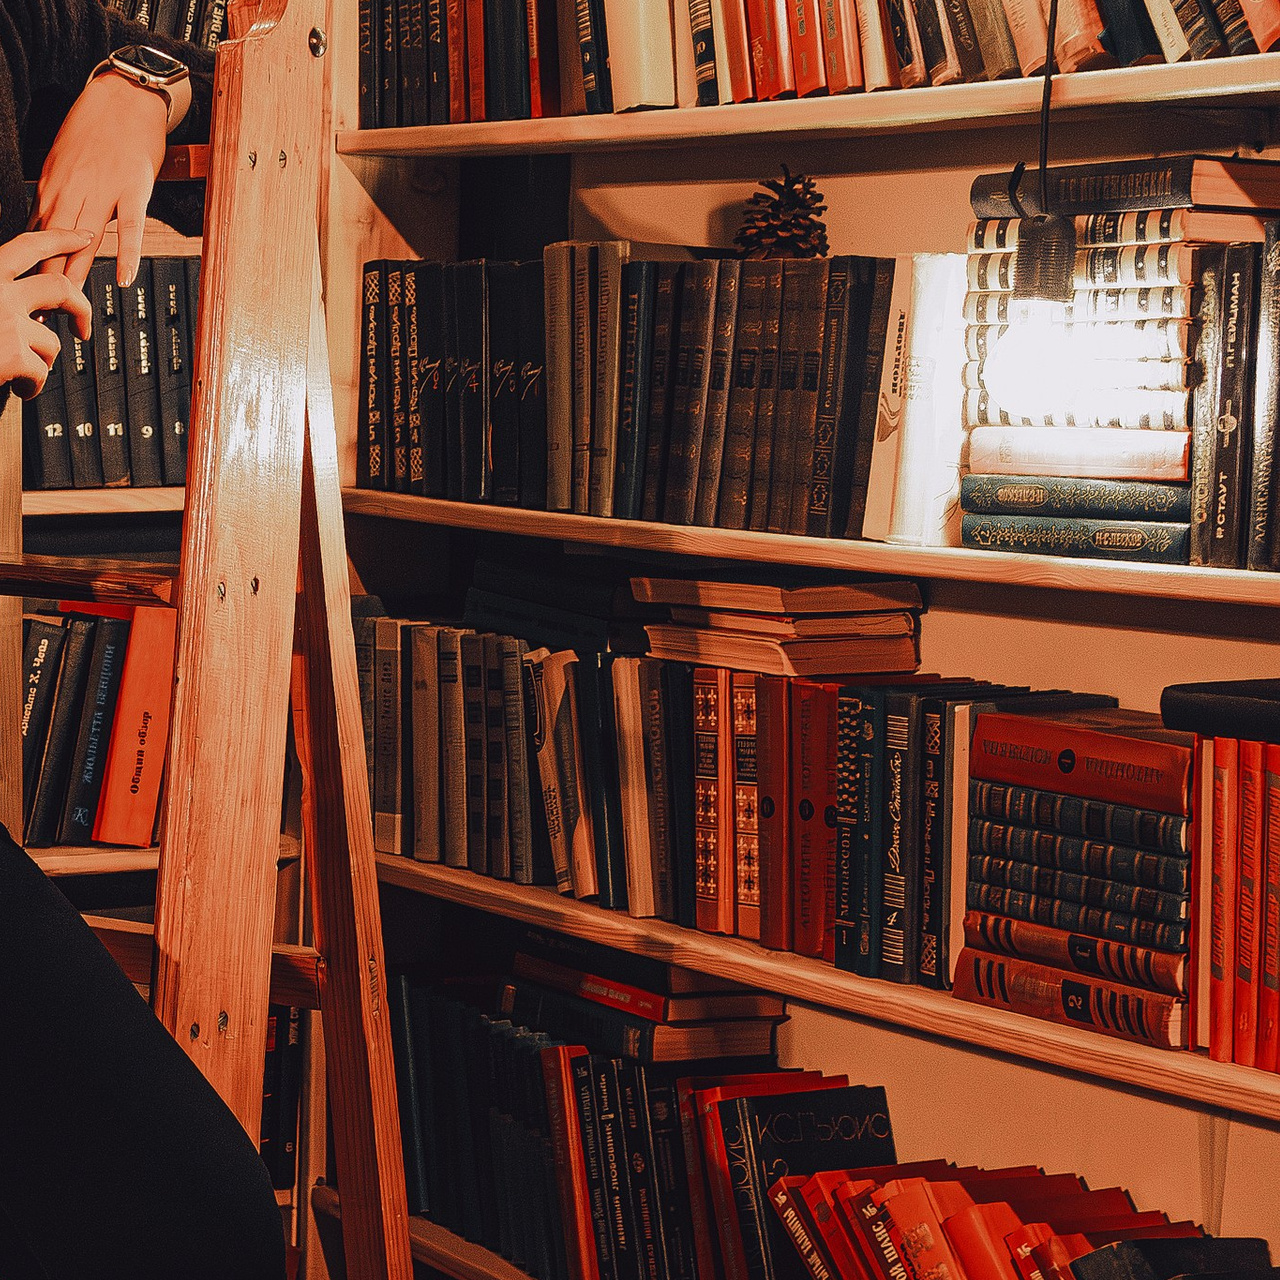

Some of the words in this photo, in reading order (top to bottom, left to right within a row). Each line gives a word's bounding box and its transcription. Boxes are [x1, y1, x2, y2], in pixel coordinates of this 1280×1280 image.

[210, 7, 223, 31] ВНЕ
[44, 423, 62, 437] 12
[75, 422, 92, 436] 10
[107, 422, 123, 436] 11
[141, 425, 152, 437] 9
[33, 637, 48, 668] Чейз
[130, 749, 143, 795] Общий
[137, 709, 150, 746] обзор
[1067, 994, 1084, 1010] 2
[603, 1121, 619, 1191] ЛЮБОВНИК
[782, 1207, 814, 1254] ТАЛАНТЫ
[870, 1219, 899, 1263] ШАНС
